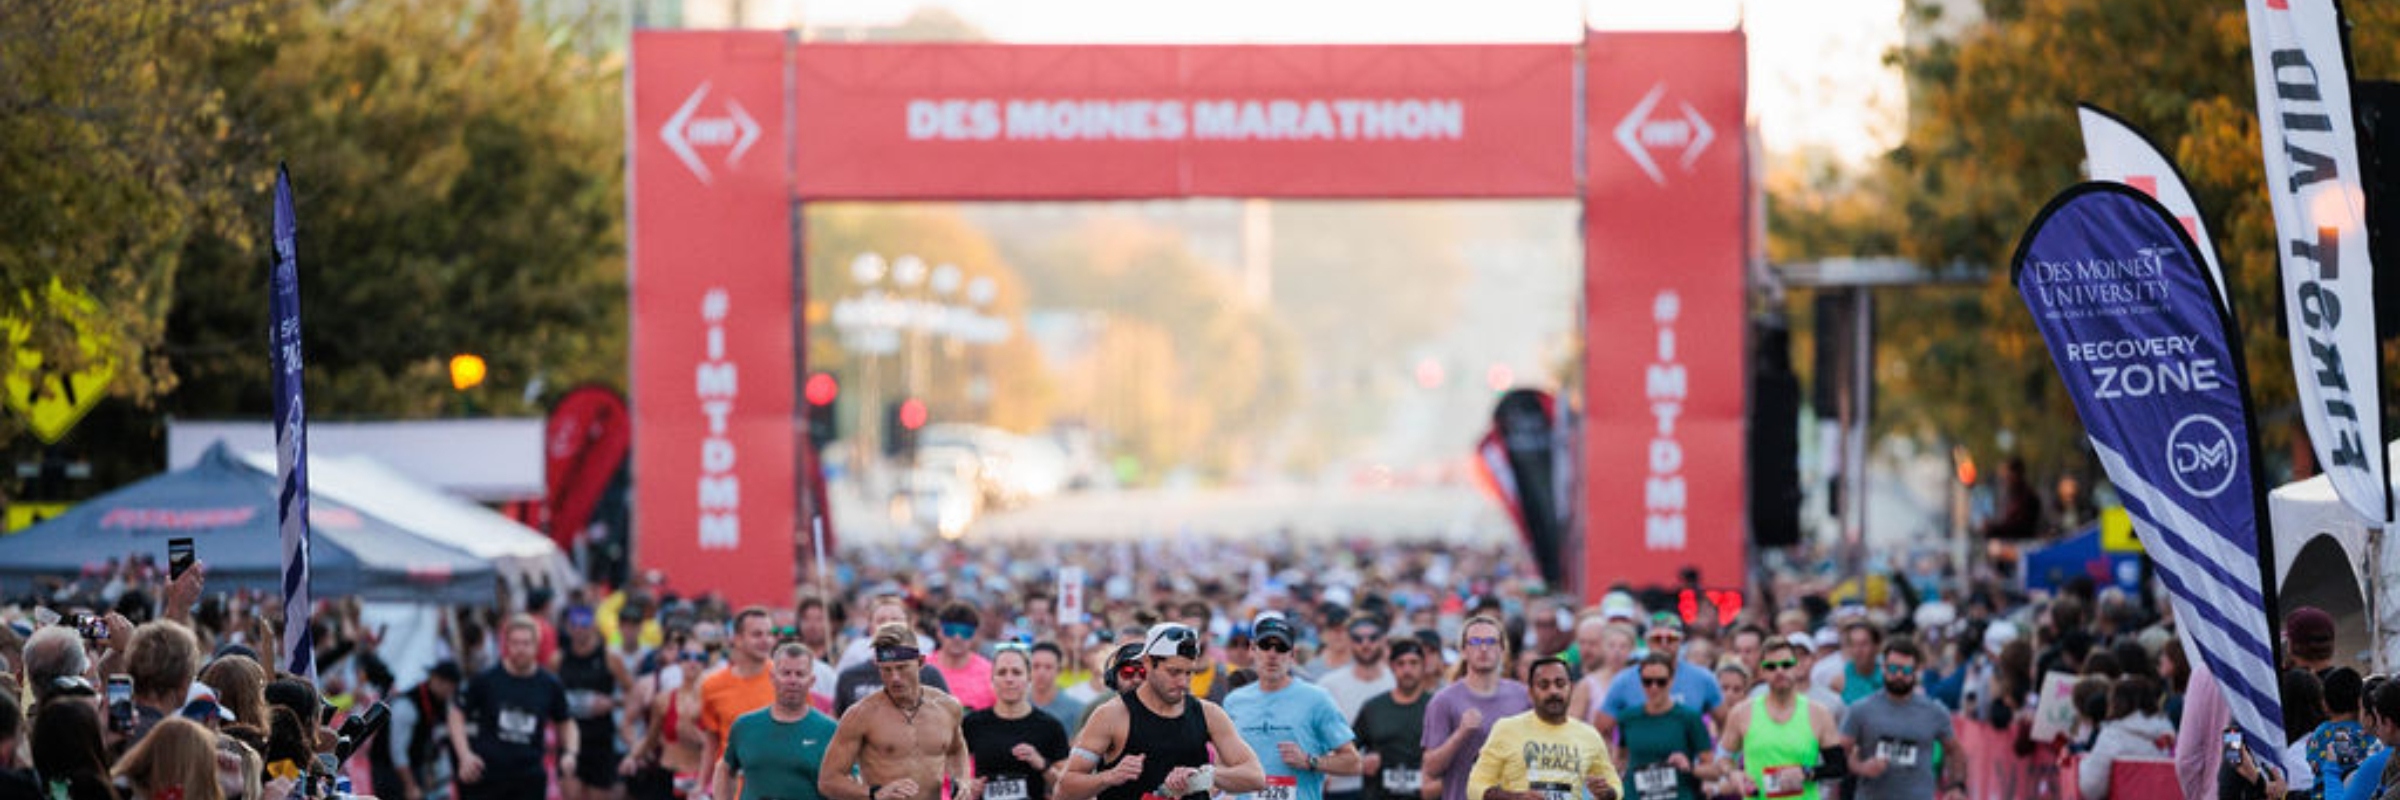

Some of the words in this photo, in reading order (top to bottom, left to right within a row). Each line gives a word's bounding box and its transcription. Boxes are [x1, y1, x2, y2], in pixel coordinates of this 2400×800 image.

[907, 99, 998, 140] DES
[1005, 99, 1187, 140] MOINES
[1194, 99, 1463, 140] MARATHON
[2035, 261, 2073, 284] DES
[2076, 256, 2154, 281] MOINES
[2038, 279, 2170, 308] UNIVERSITY
[2066, 334, 2199, 361] RECOVERY
[2091, 359, 2221, 399] ZONE
[696, 287, 739, 549] #IMTDMM
